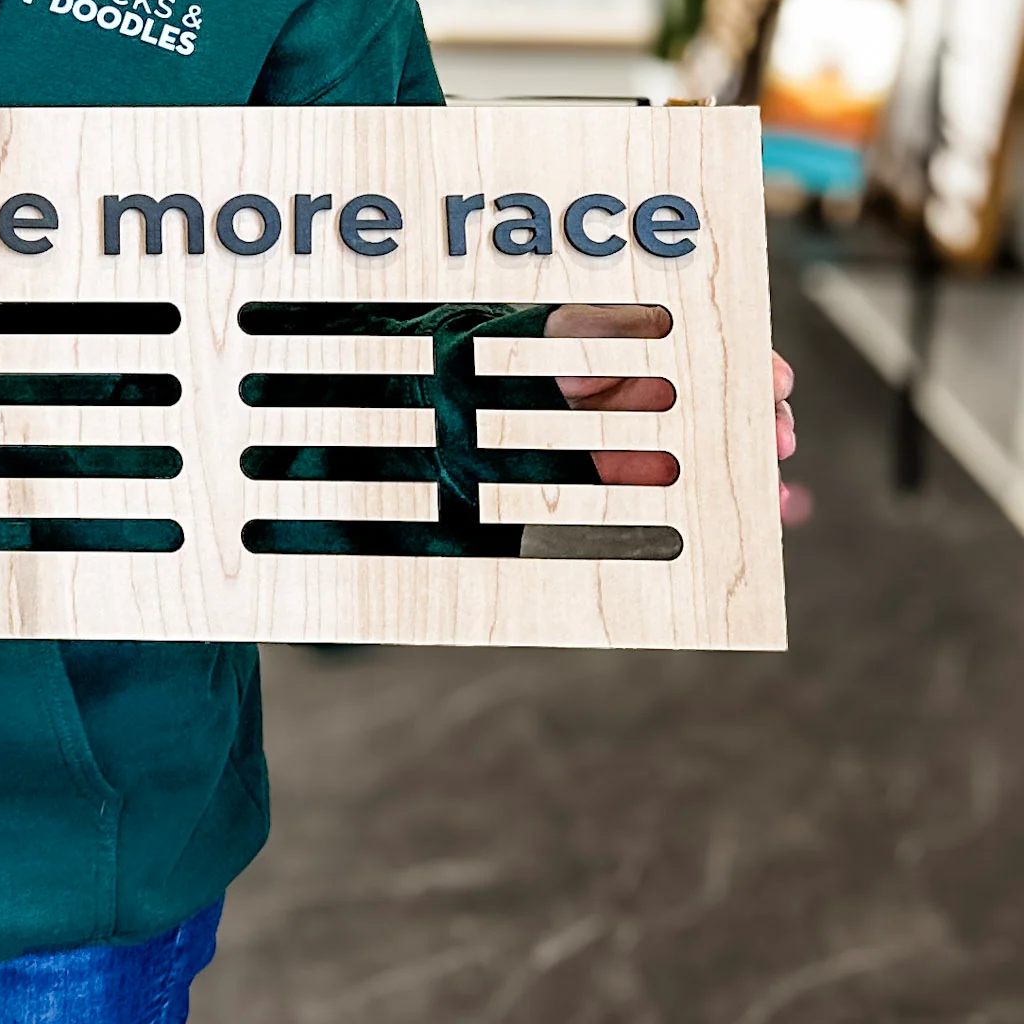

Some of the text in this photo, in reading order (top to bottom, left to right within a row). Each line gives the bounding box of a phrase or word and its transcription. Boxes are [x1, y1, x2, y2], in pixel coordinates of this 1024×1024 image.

[181, 4, 203, 30] &
[103, 193, 403, 257] more
[446, 192, 700, 258] race
